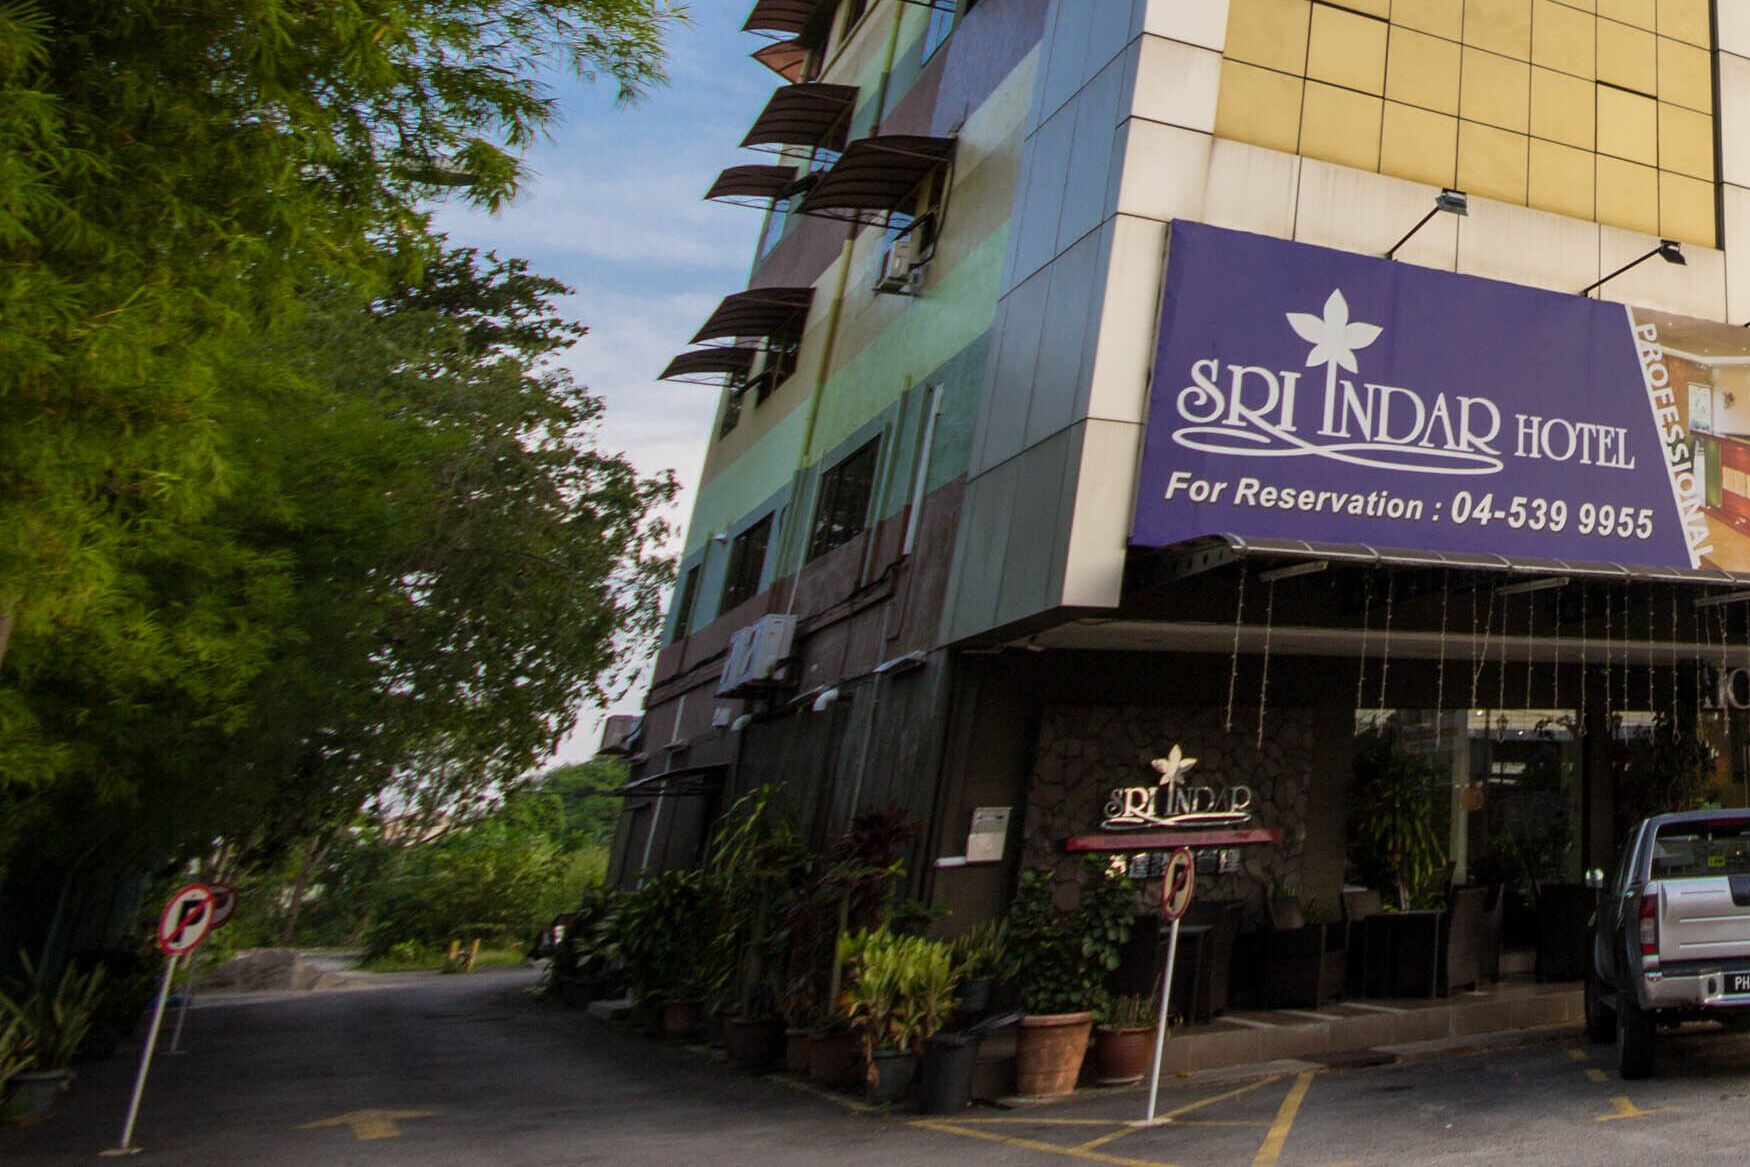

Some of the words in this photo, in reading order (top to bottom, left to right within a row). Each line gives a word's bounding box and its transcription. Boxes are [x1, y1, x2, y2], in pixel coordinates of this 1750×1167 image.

[1176, 359, 1302, 434] SRI
[1317, 359, 1501, 454] INDAR
[1515, 414, 1636, 470] HOTEL
[1634, 324, 1716, 569] PROFESSIONAL
[1165, 471, 1227, 502] For
[1233, 477, 1423, 520] Reservation
[1451, 491, 1567, 531] 04-539
[1578, 504, 1653, 539] 9955
[1104, 786, 1158, 818] SRI
[1163, 782, 1252, 816] INDAR
